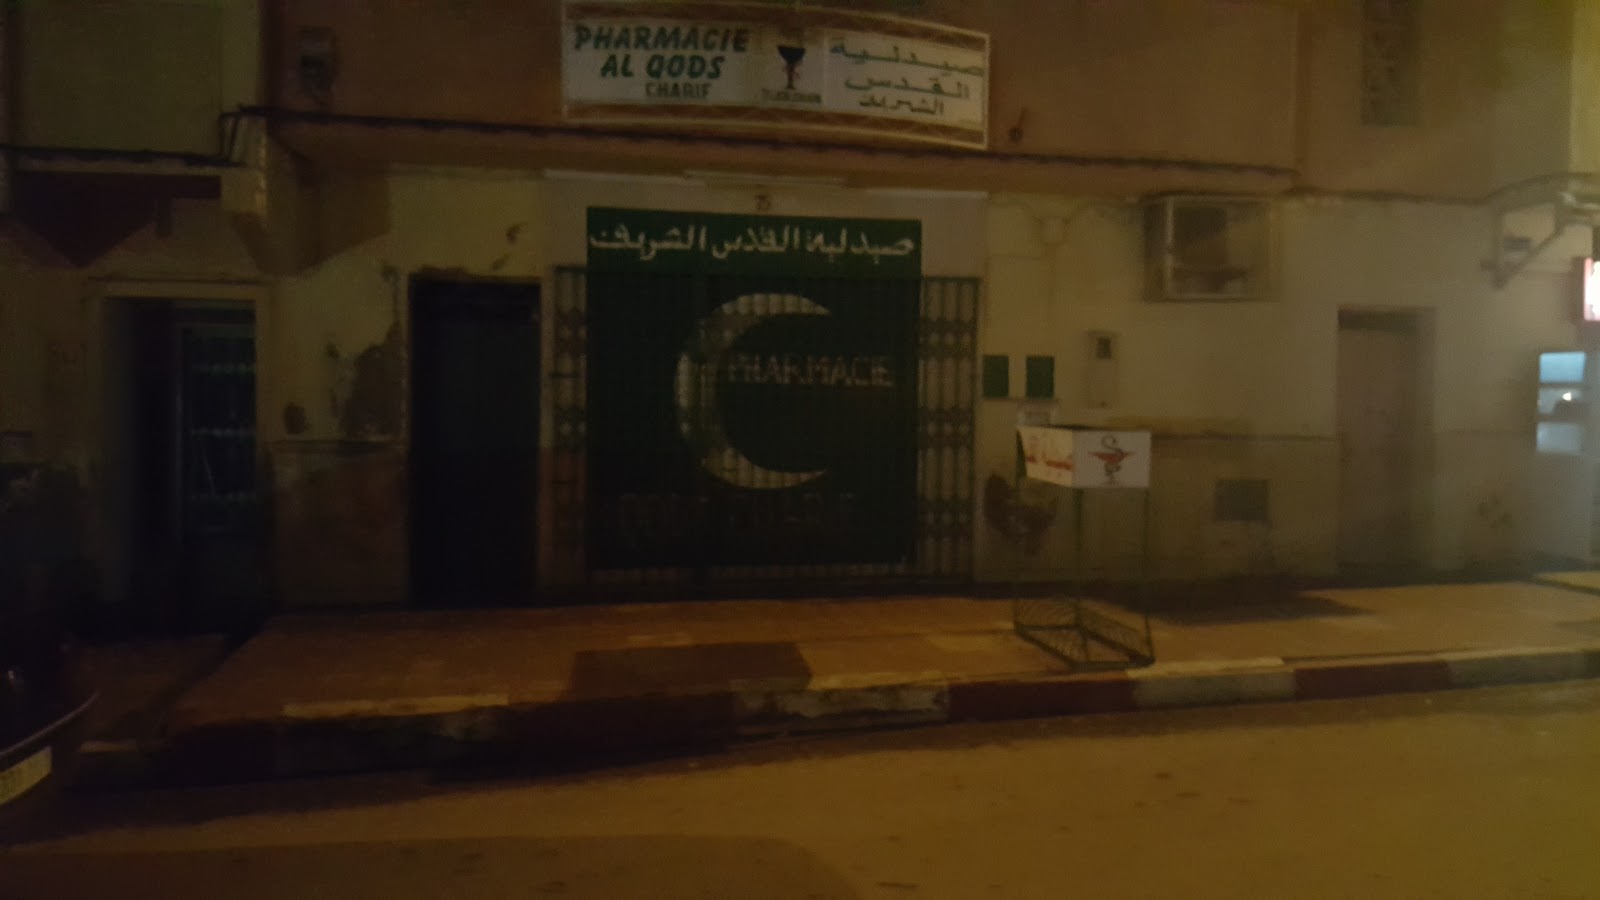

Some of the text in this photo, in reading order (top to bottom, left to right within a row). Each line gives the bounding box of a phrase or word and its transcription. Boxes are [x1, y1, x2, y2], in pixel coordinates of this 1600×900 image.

[574, 25, 748, 51] PHARMACIE
[601, 54, 725, 79] AL QODS
[645, 82, 711, 98] CHARIF
[590, 223, 707, 262] الشريف
[711, 225, 800, 260] القدس
